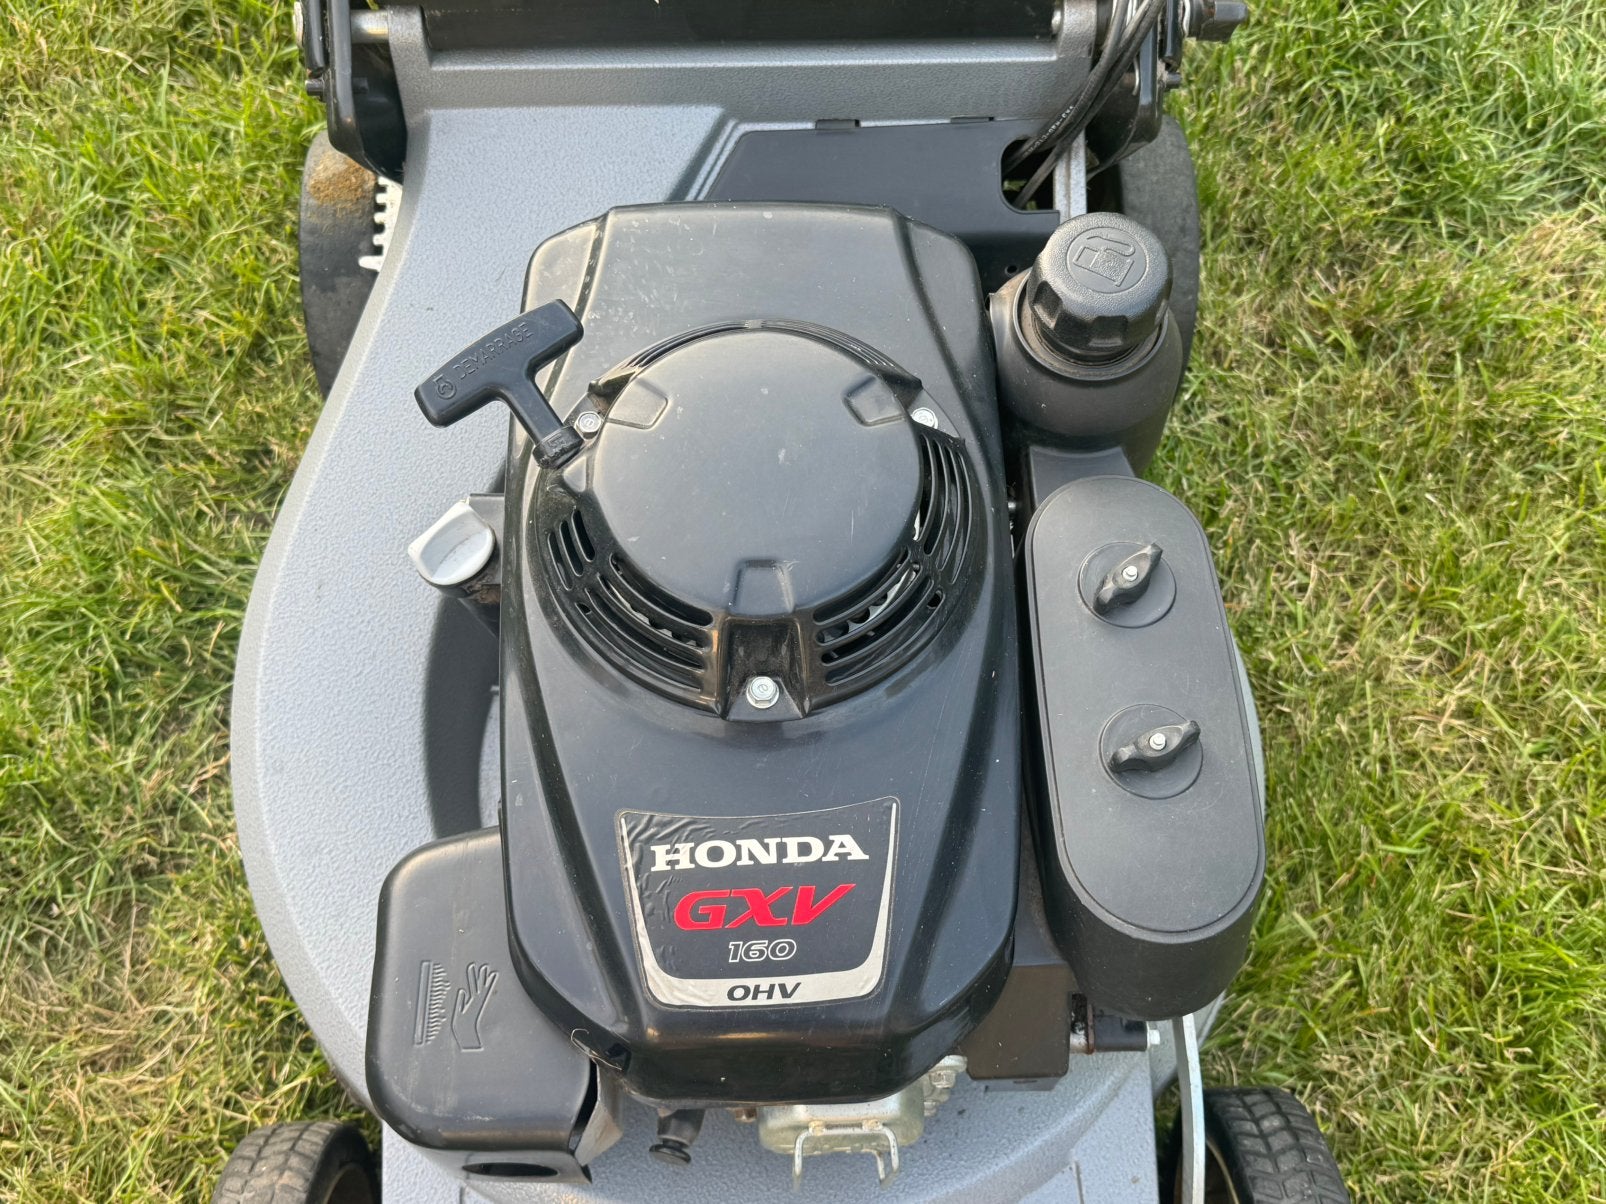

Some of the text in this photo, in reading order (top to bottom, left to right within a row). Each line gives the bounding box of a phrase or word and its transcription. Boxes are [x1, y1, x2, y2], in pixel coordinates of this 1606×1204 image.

[453, 321, 534, 380] DEMARRAGE
[650, 834, 870, 872] HONDA
[673, 883, 857, 931] GXV
[728, 938, 797, 963] 160
[726, 982, 802, 1001] OHV
